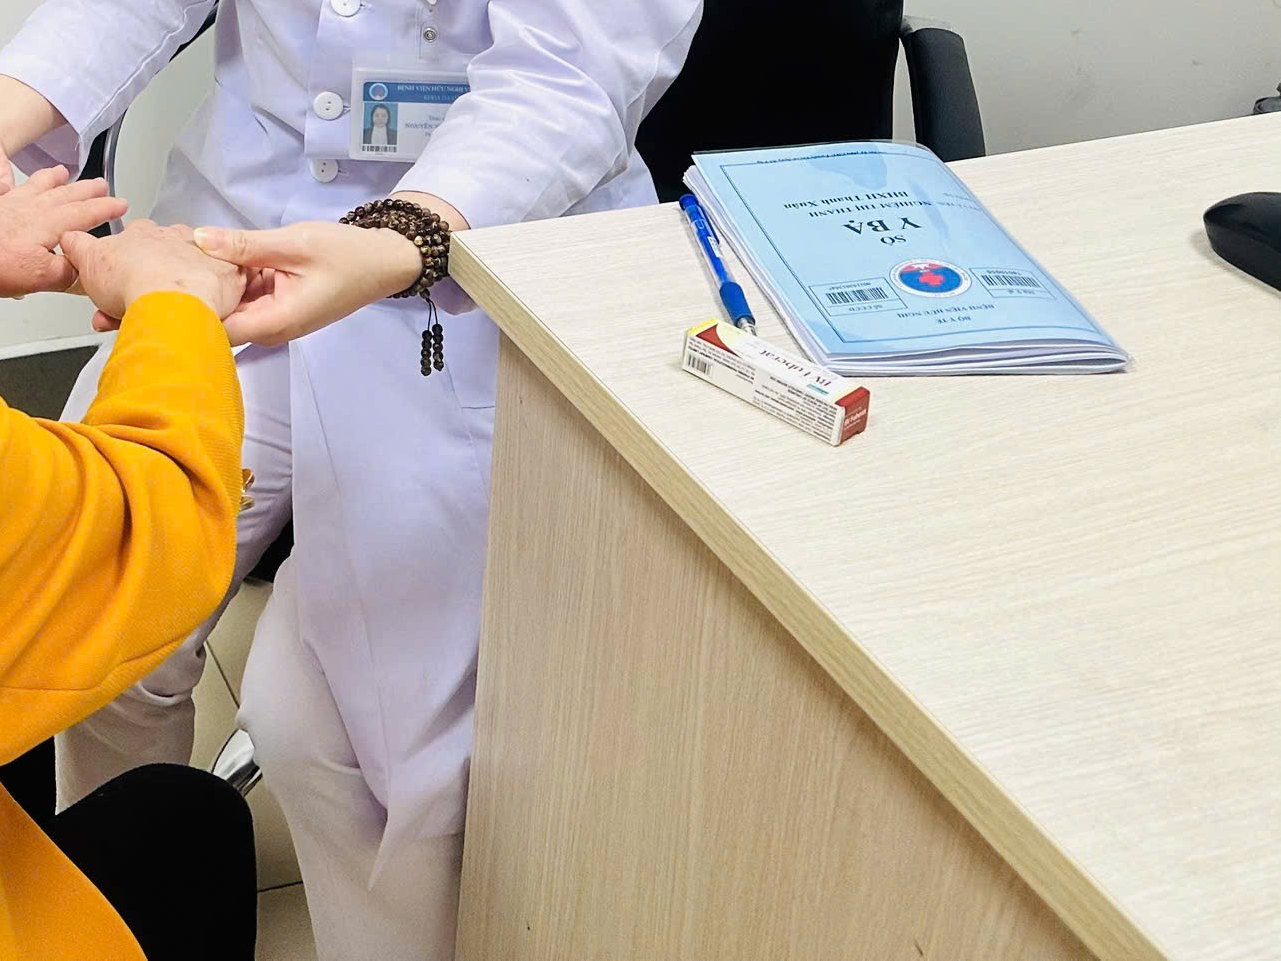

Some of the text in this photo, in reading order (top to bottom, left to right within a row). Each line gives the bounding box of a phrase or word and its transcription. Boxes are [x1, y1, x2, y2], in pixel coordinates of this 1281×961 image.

[783, 191, 909, 211] BHXH Thanh Xuân
[856, 203, 877, 212] THỊ
[808, 207, 853, 217] THANH
[842, 217, 922, 235] Y BẠ
